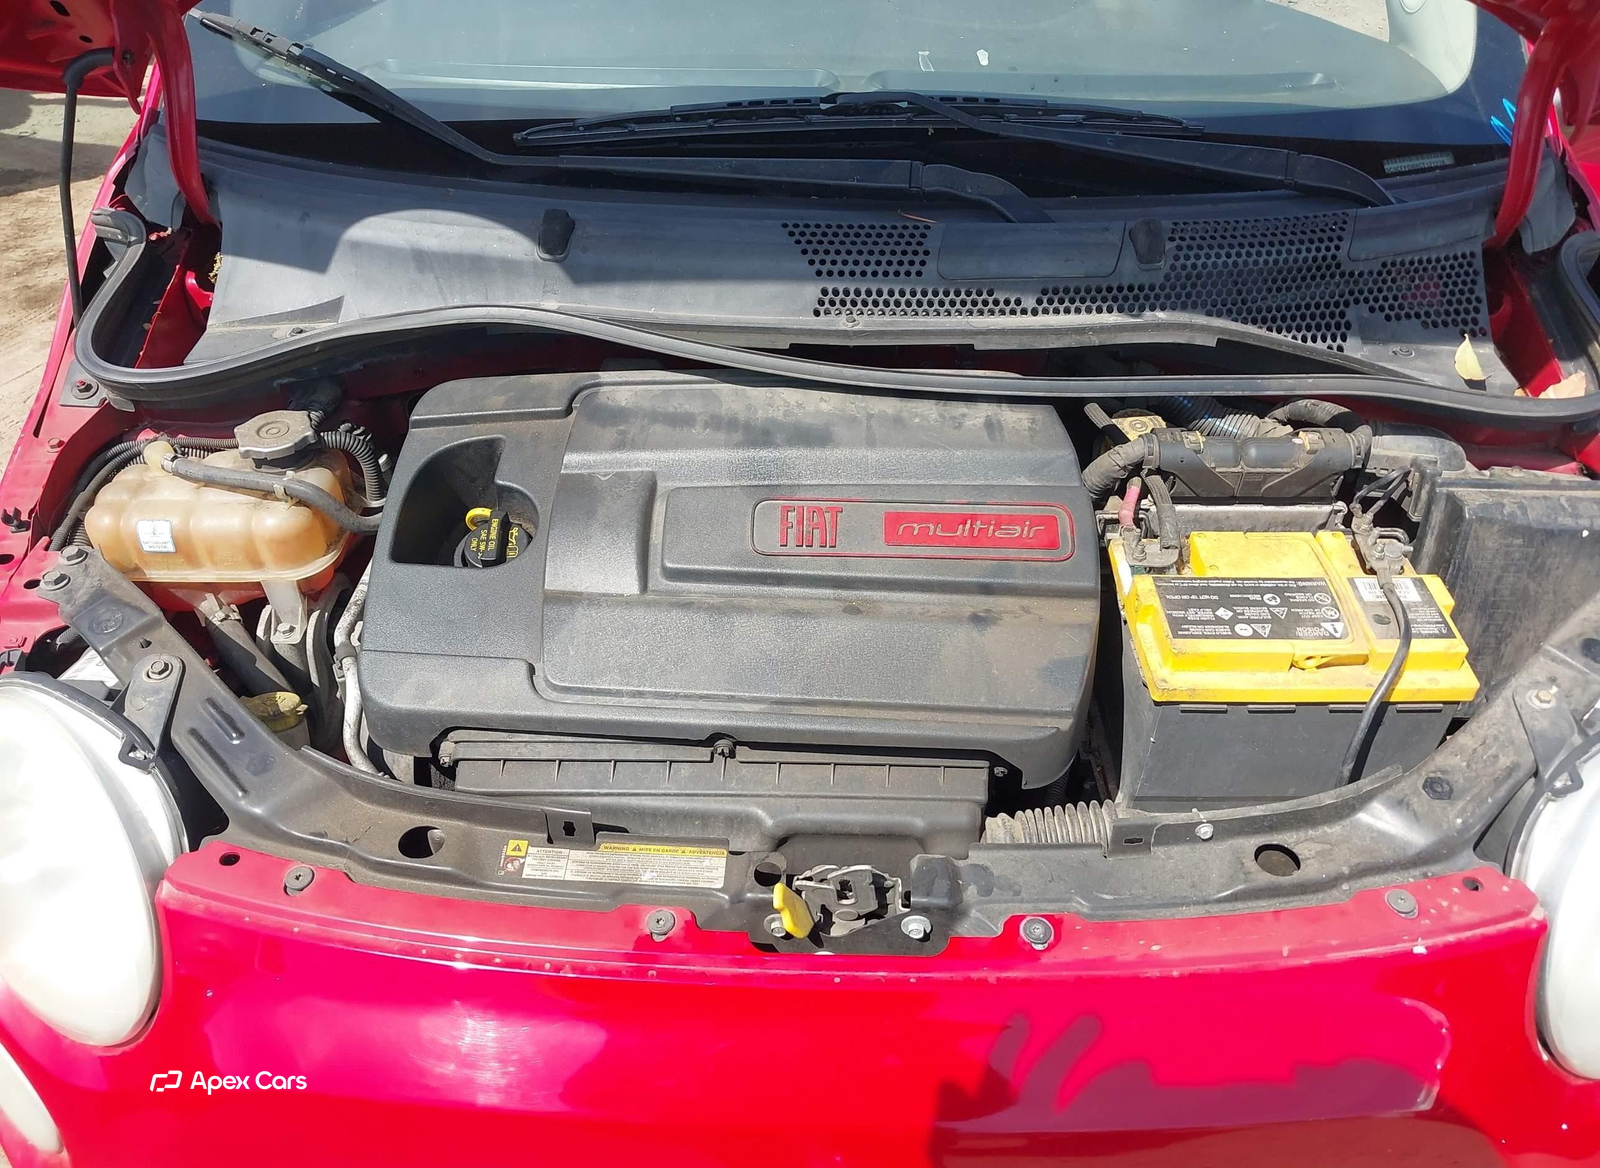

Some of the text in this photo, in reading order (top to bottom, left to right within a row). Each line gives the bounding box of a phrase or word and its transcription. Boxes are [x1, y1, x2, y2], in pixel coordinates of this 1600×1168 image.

[480, 529, 488, 541] SAE
[487, 518, 499, 551] ENGINE OIL
[779, 504, 843, 548] FIAT
[897, 518, 1045, 540] multiair
[470, 537, 478, 552] ONLY
